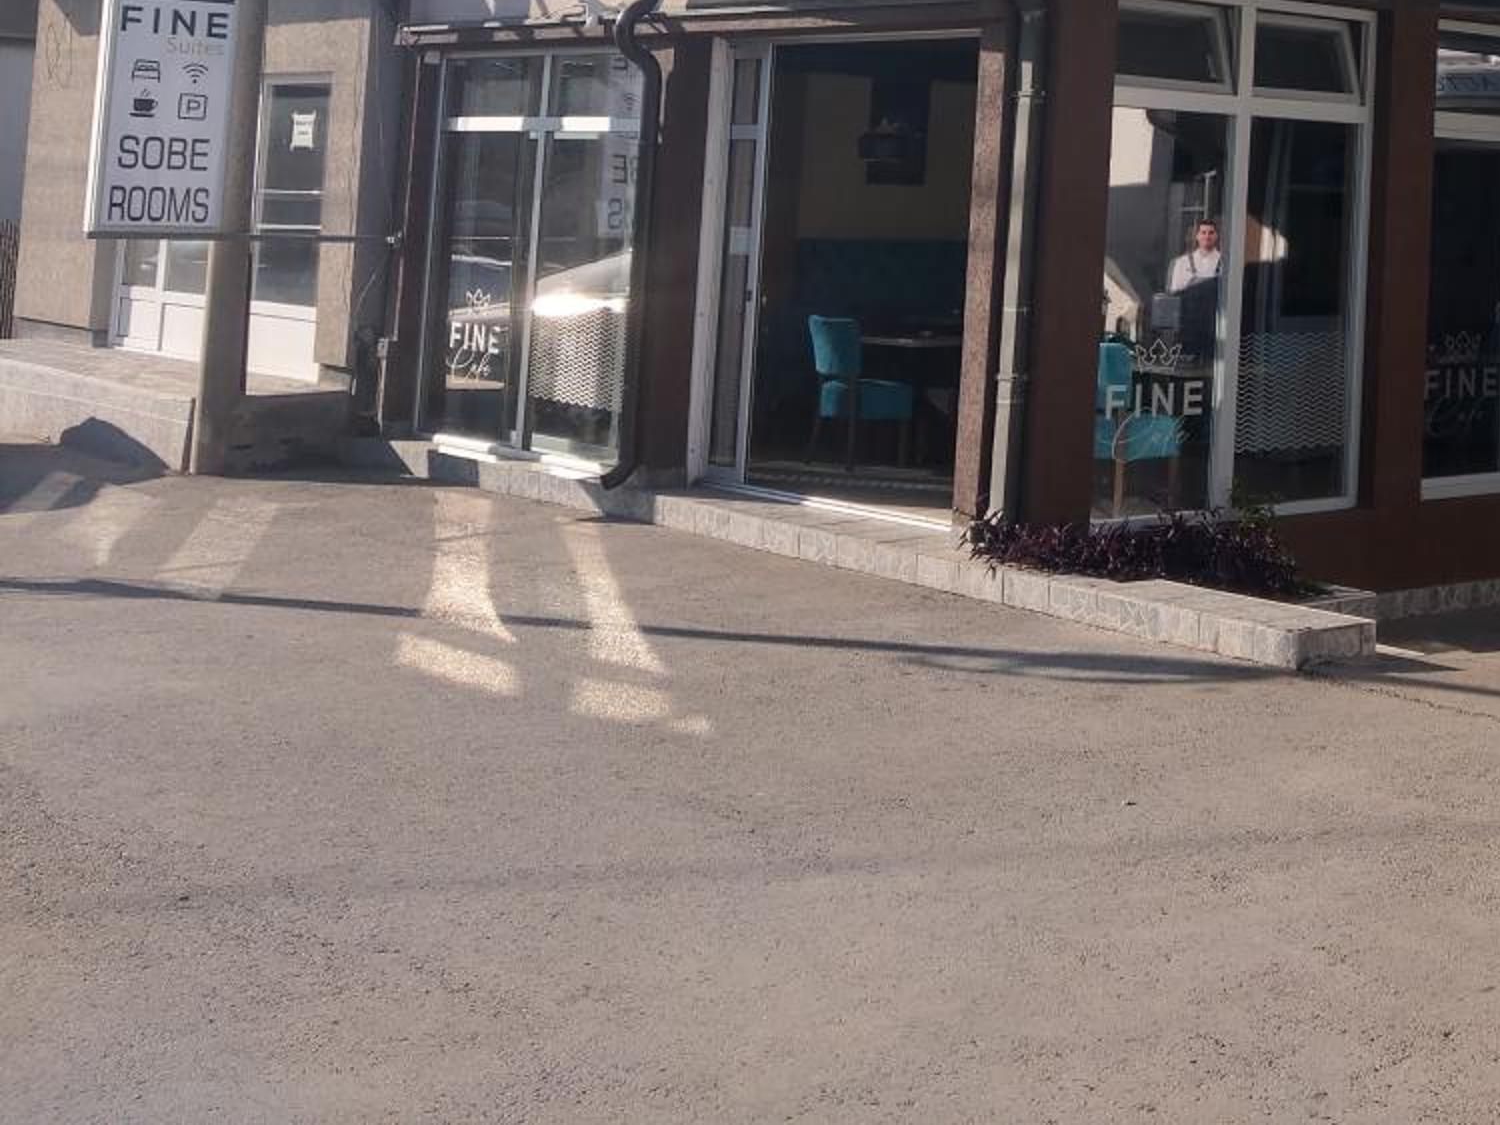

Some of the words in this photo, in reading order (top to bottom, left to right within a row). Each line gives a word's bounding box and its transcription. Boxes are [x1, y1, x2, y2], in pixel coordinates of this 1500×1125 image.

[120, 5, 229, 40] FINE
[118, 134, 211, 172] SOBE
[107, 184, 210, 223] ROOMS
[449, 321, 501, 355] FINE
[1104, 380, 1204, 420] FINE
[1423, 366, 1498, 401] FINE
